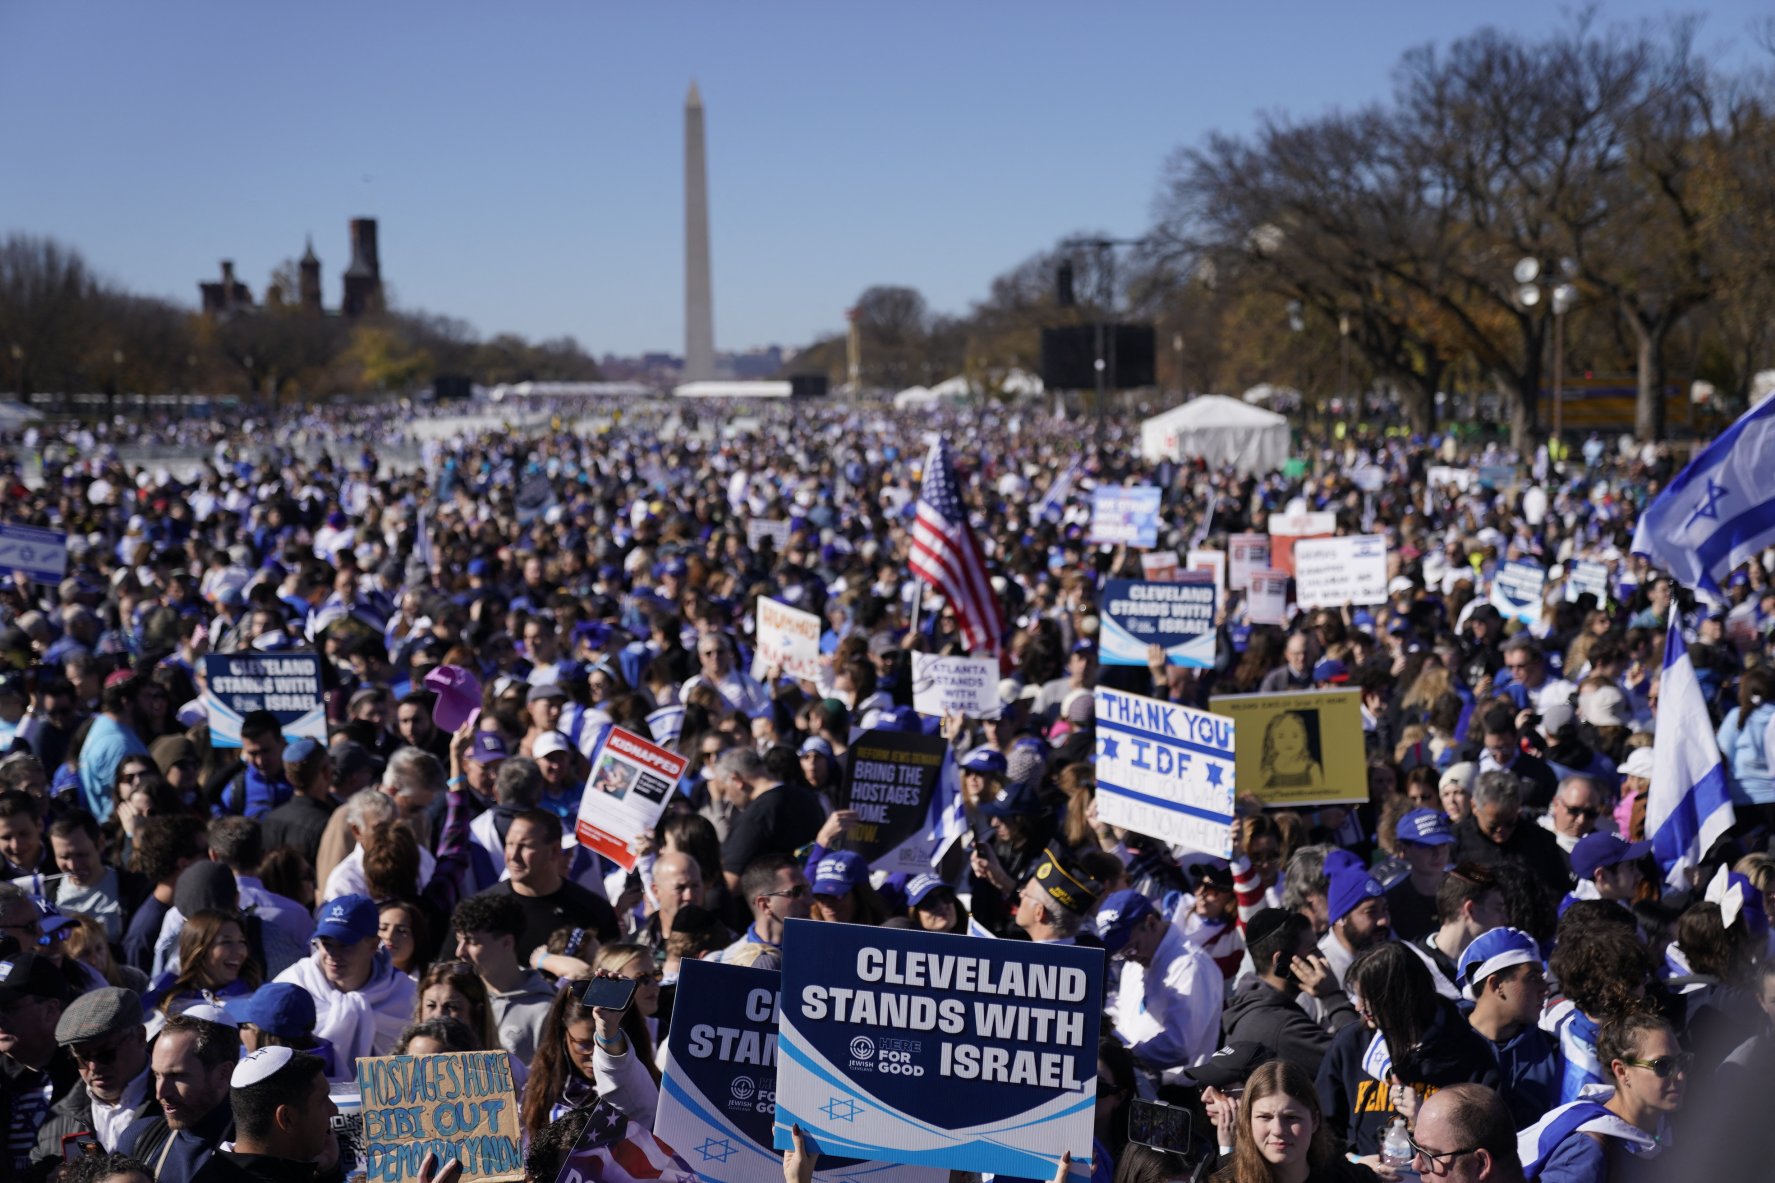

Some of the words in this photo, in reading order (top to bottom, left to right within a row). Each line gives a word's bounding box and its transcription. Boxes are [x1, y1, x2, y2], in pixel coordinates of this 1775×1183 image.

[1128, 584, 1214, 603] CLEVELAND
[1109, 599, 1170, 617] STANDS
[1170, 602, 1213, 619] WITH
[1158, 617, 1210, 634] ISRAEL
[229, 658, 316, 676] CLEVELAND
[933, 664, 987, 674] ATLANTA
[212, 675, 274, 694] STANDS
[274, 676, 318, 694] WITH
[937, 676, 984, 687] STANDS
[264, 693, 316, 712] ISRAEL
[945, 689, 977, 699] WITH
[1102, 692, 1176, 737] THANK
[1184, 711, 1229, 748] YOU
[609, 735, 680, 775] KIDNAPPED
[854, 760, 896, 783] BRING
[898, 765, 924, 785] THE
[851, 782, 921, 806] HOSTAGES
[856, 946, 1088, 1003] CLEVELAND
[801, 984, 966, 1035] STANDS
[973, 1001, 1085, 1047] WITH
[879, 1037, 922, 1053] HERE
[848, 1059, 874, 1068] JEWISH
[878, 1049, 912, 1064] FOR
[939, 1041, 1083, 1091] ISRAEL
[878, 1061, 925, 1077] GOOD
[358, 1055, 462, 1107] HOSTAGES
[461, 1052, 515, 1098] HOME
[365, 1105, 427, 1142] BIBI
[432, 1099, 506, 1137] OUT
[480, 1135, 524, 1175] NOW
